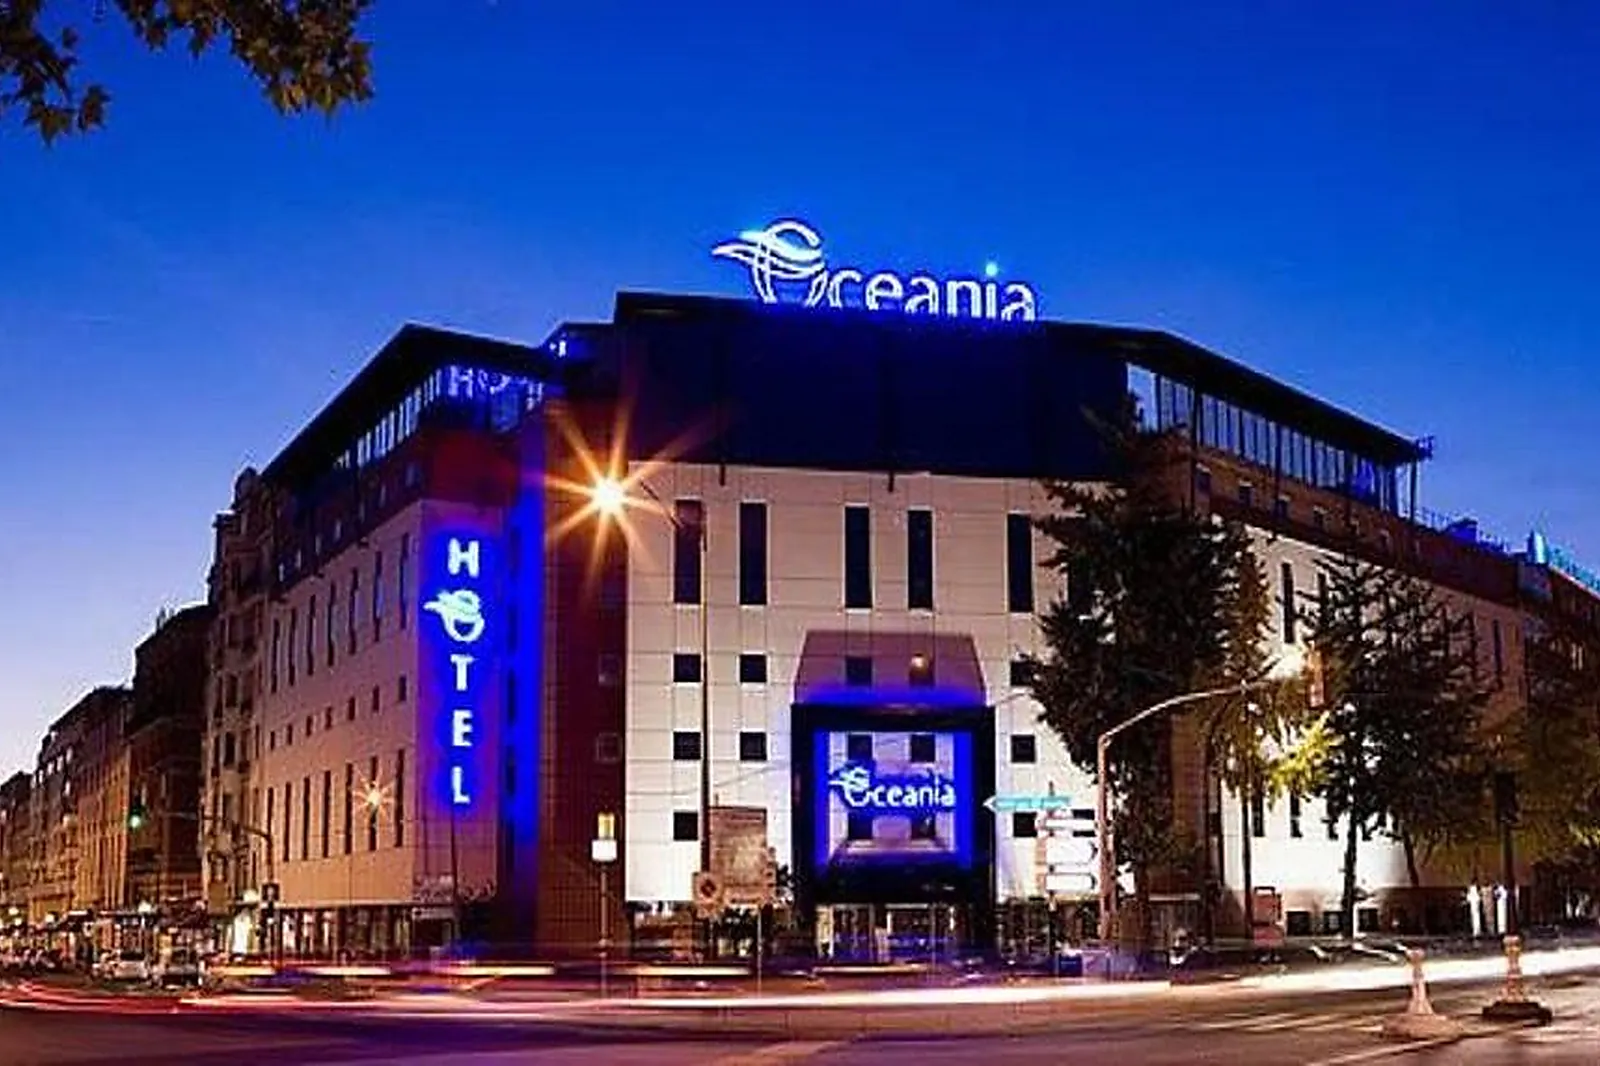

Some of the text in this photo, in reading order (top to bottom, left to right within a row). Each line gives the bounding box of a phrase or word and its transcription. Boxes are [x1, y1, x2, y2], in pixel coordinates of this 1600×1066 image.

[711, 219, 1036, 321] Oceania
[424, 538, 485, 806] HOTEL
[829, 766, 956, 808] Oceania
